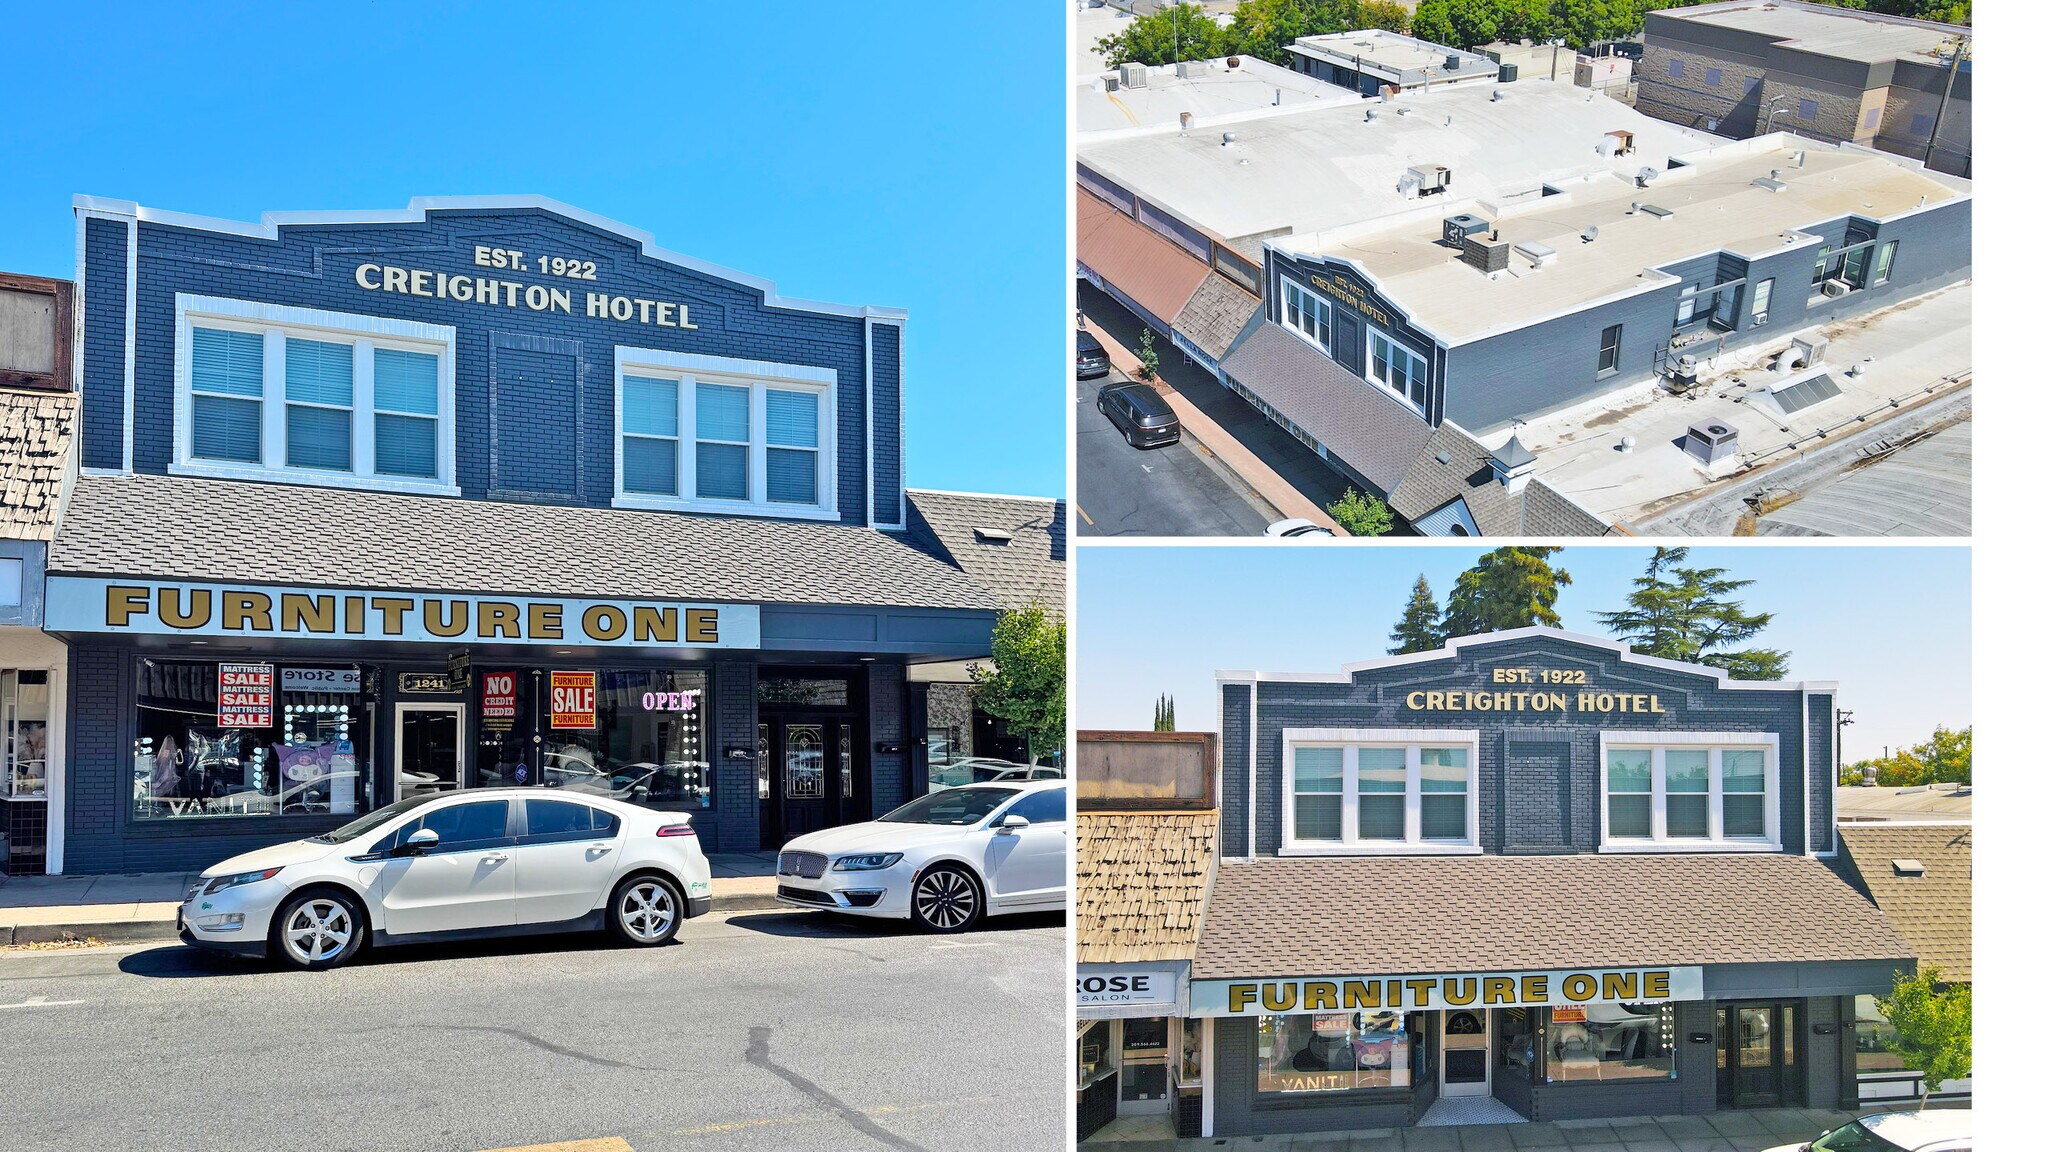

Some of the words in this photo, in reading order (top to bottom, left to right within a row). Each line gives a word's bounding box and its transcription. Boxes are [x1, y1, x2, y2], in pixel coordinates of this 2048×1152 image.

[475, 245, 527, 271] EST.
[538, 255, 597, 281] 1922
[355, 263, 571, 314] CREIGHTON
[586, 292, 699, 330] HOTEL
[1310, 274, 1358, 308] CREIGHTON
[1360, 301, 1389, 327] HOTEL
[106, 585, 563, 639] FURNITURE
[581, 604, 719, 643] ONE
[223, 673, 270, 685] SALE
[415, 679, 445, 688] 1241
[553, 677, 593, 685] FURNITURE
[1492, 668, 1533, 684] EST.
[1541, 669, 1586, 684] 1922
[486, 676, 512, 694] NO
[223, 693, 270, 705] SALE
[484, 697, 514, 705] CREDIT
[553, 688, 593, 713] SALE
[642, 692, 692, 711] OPEN
[1406, 691, 1567, 711] CREIGHTON
[1577, 694, 1666, 713] HOTEL
[222, 714, 269, 725] SALE
[483, 707, 515, 716] NEEDED
[553, 715, 594, 723] FURNITURE
[1228, 975, 1549, 1013] FURNITURE
[1561, 971, 1671, 1002] ONE
[1315, 1021, 1347, 1029] SALE
